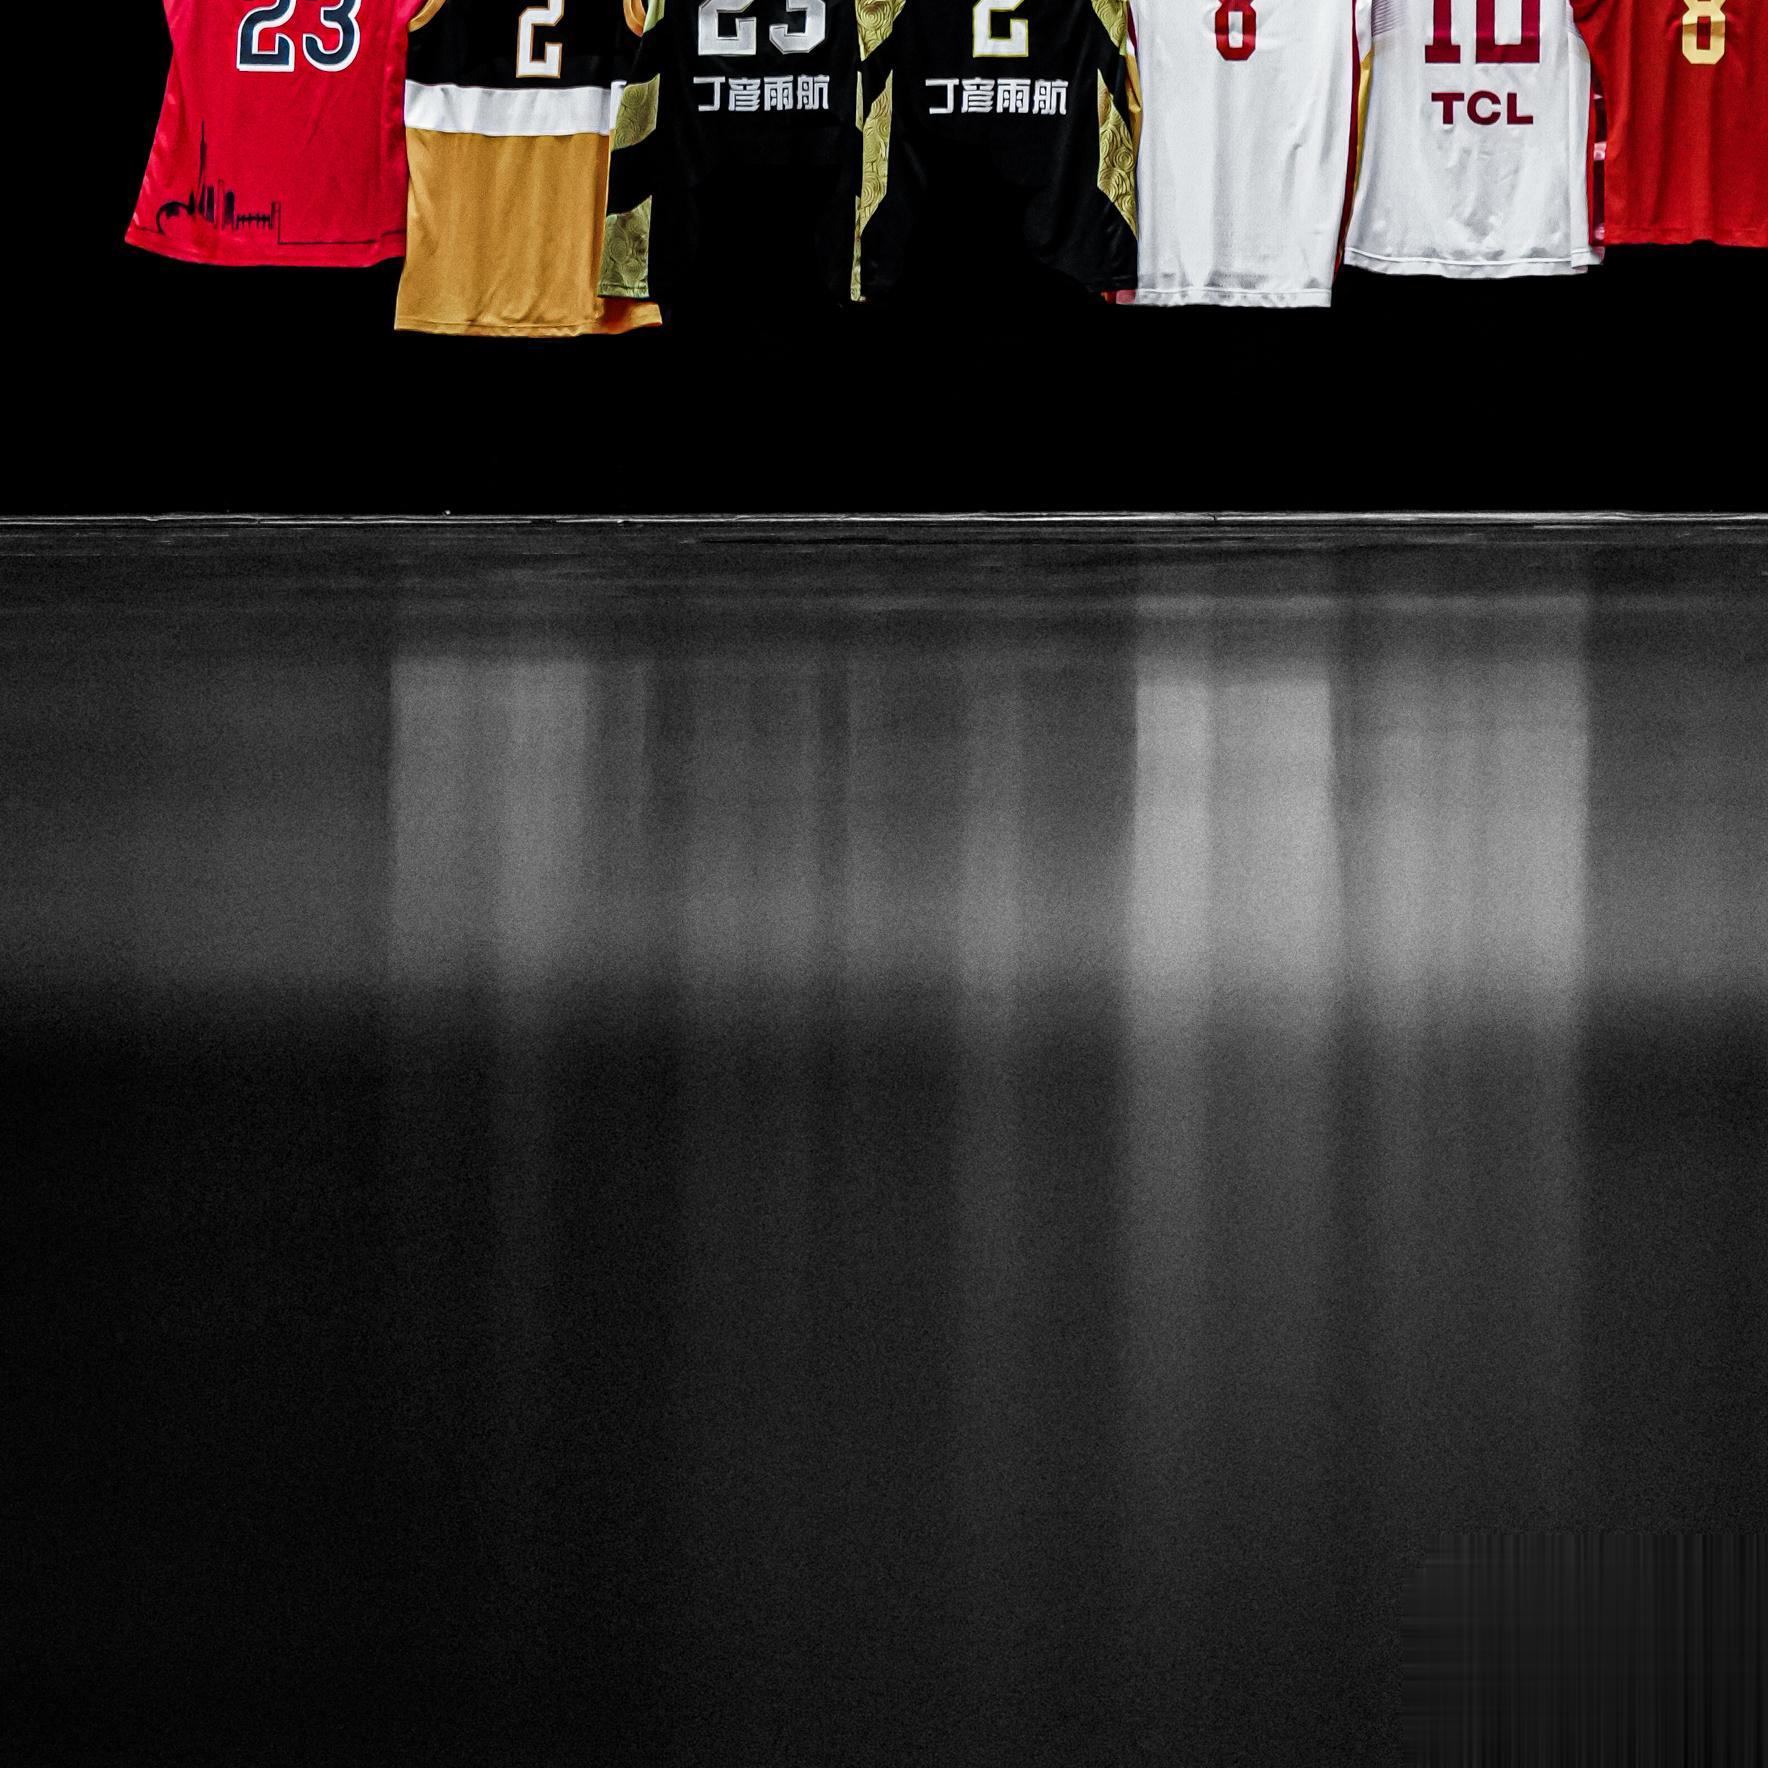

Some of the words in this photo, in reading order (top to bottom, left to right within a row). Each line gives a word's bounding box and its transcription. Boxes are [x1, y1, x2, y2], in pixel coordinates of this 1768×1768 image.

[693, 75, 830, 112] 丁彦雨航
[925, 77, 1068, 116] 丁彦雨航
[1431, 90, 1534, 126] TCL
